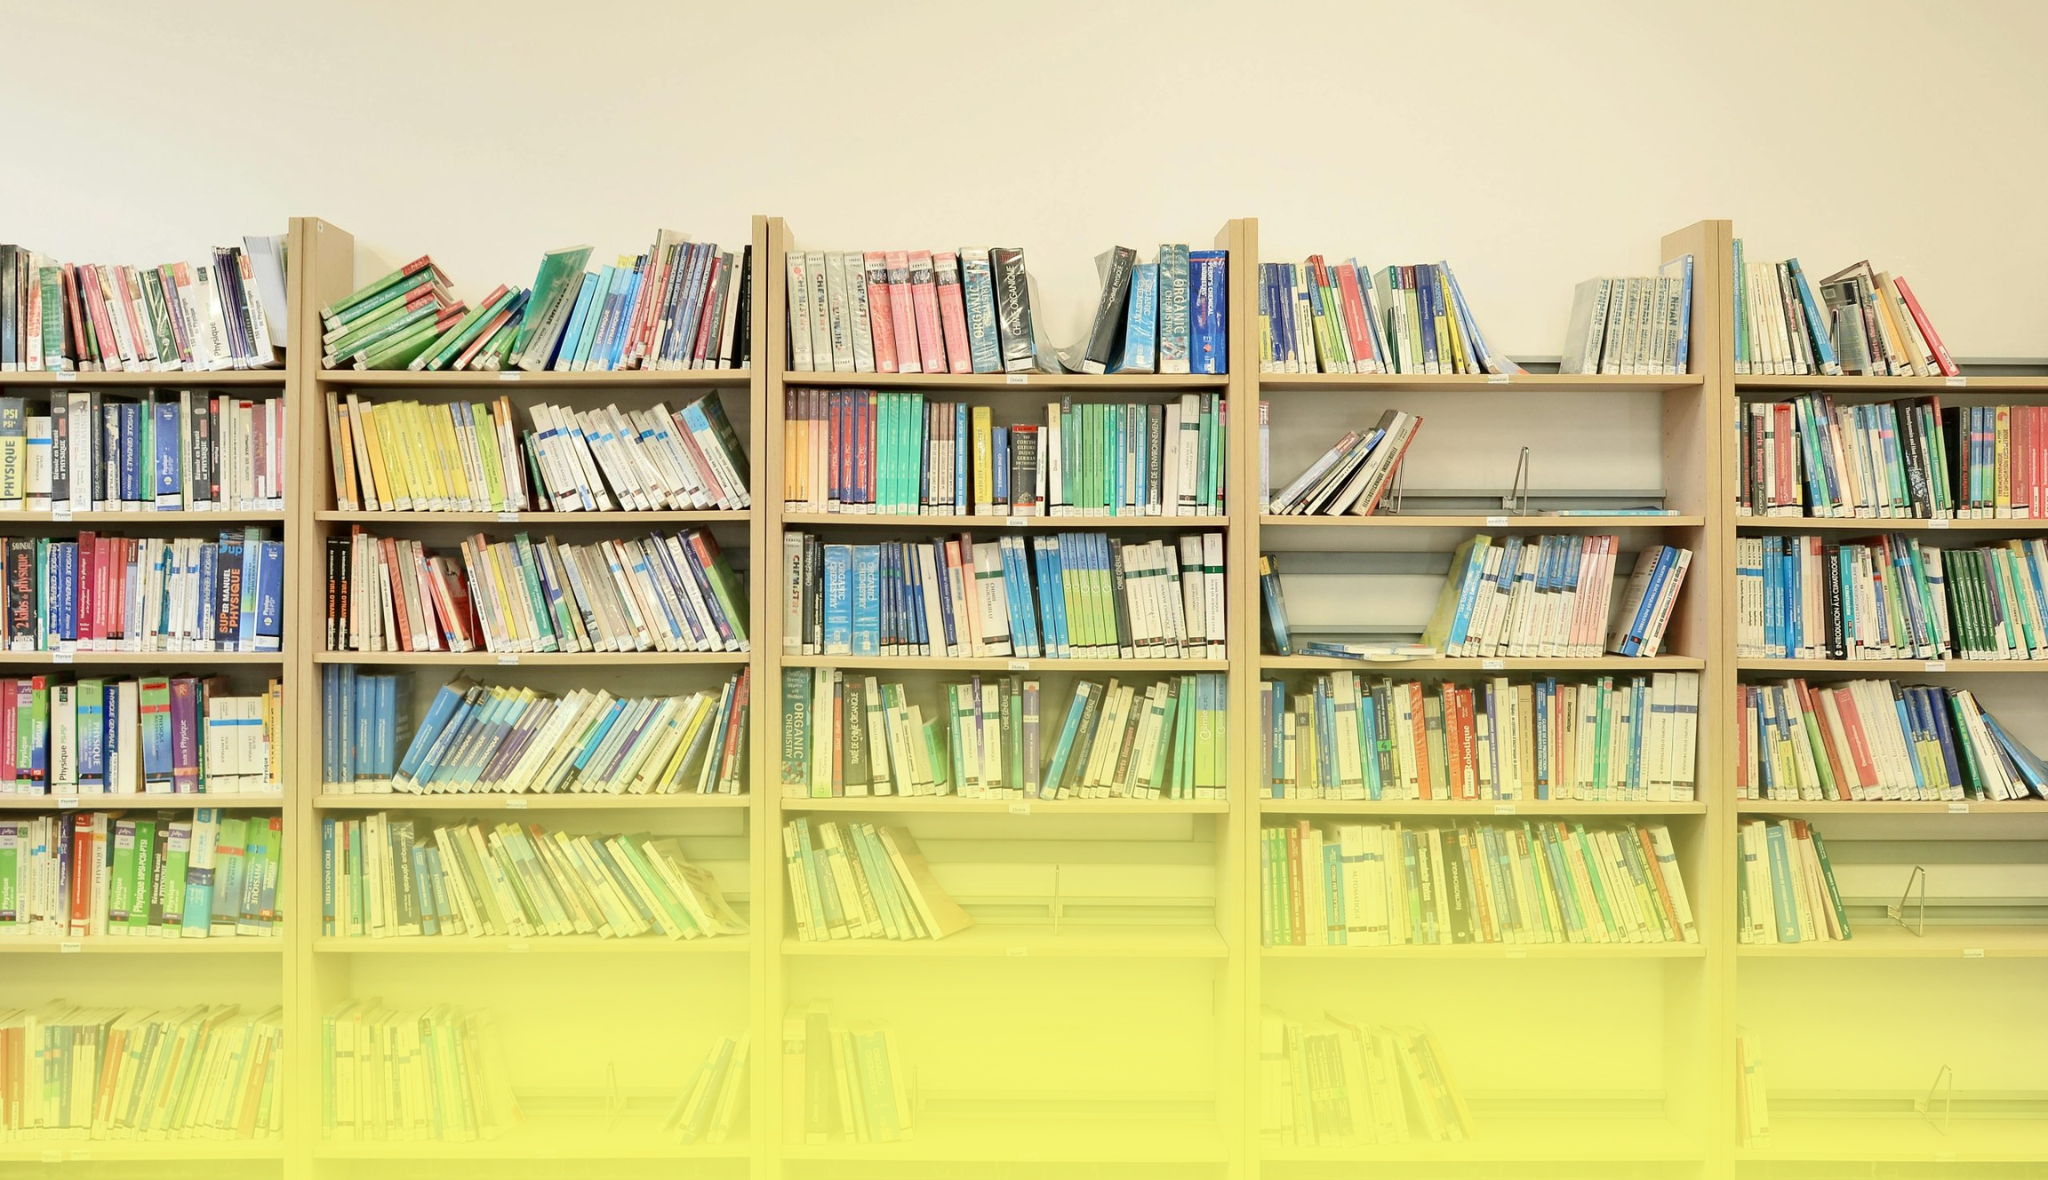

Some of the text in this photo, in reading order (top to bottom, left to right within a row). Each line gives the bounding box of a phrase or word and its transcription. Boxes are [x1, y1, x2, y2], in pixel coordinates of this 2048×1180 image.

[970, 285, 984, 338] ORGANIC
[1006, 266, 1022, 336] CHIMIE ORGANIQUE
[1173, 278, 1184, 334] ORGANIC
[209, 322, 222, 356] Physique
[596, 310, 610, 344] DYNAMIQUE
[606, 310, 619, 345] DYNAMIQUE
[3, 409, 18, 419] PSI
[126, 408, 134, 436] PHYSIQUE
[1756, 417, 1764, 446] ransferts
[1905, 406, 1915, 438] Thermodynamics
[1151, 418, 1159, 470] L'ENVIRONNEMENT
[5, 440, 15, 497] PHYSIQUE
[1756, 448, 1764, 484] thermiques
[17, 554, 32, 592] physique
[792, 555, 800, 616] CHEMISTRY
[830, 562, 838, 609] CHEMISTRY
[838, 562, 846, 600] ORGANIC
[1830, 555, 1840, 594] CLIMATOLOGIE
[15, 601, 27, 621] kilos
[219, 569, 230, 633] SUPER MANUEL
[230, 568, 240, 627] PHYSIQUE
[985, 583, 993, 619] INDUSTRIELLE
[1833, 594, 1840, 602] LA
[1834, 607, 1842, 649] INTRODUCTION
[36, 721, 44, 748] PHYSIQUE
[180, 720, 188, 748] Physique
[785, 714, 793, 758] CHEMISTRY
[794, 702, 804, 759] ORGANIC
[1200, 710, 1211, 740] Chimie
[20, 736, 29, 767] Physique
[93, 722, 101, 765] PHYSIQUE
[451, 735, 472, 767] DYNAMIQUE
[464, 736, 486, 767] DYNAMIQUE
[476, 736, 500, 767] DYNAMIQUE
[851, 749, 859, 765] TRAITÉ
[1463, 725, 1473, 770] Robotique
[59, 745, 68, 781] Physique
[134, 839, 147, 912] Physique MPSI-PCSI-PTSI
[267, 861, 275, 889] PHYSIQUE
[399, 827, 409, 892] Mécanique générale
[2, 878, 11, 909] Physique
[115, 877, 125, 910] Physique
[166, 881, 176, 913] Physique
[251, 863, 261, 904] PHYSIQUE
[434, 874, 444, 904] FONDERIE
[1352, 870, 1360, 920] AUTOMATIQUE
